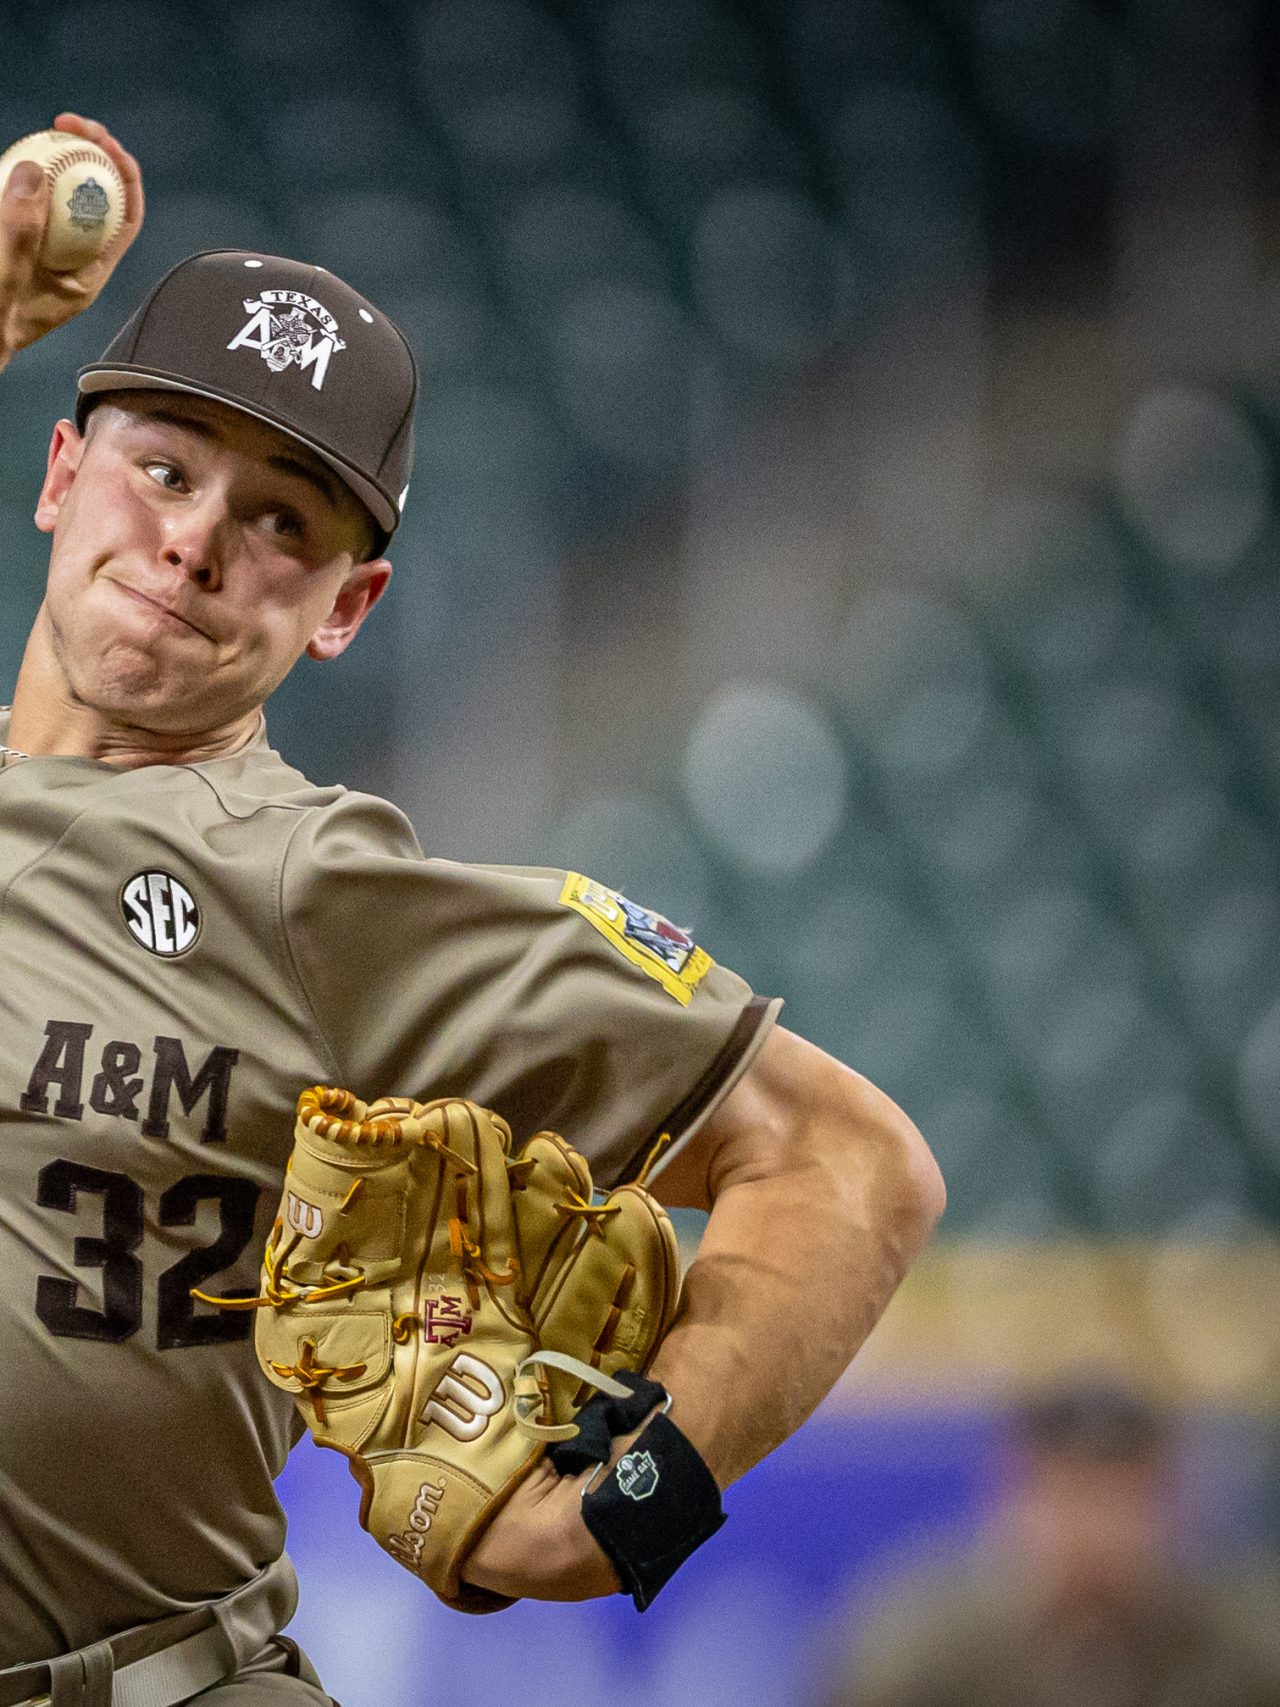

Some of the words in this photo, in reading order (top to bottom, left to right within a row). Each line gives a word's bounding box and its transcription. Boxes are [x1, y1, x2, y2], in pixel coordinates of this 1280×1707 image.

[270, 291, 333, 325] TEXAS
[123, 873, 197, 953] SEC
[20, 1020, 239, 1143] A&M
[35, 1158, 261, 1351] 32
[388, 1482, 445, 1566] lson
